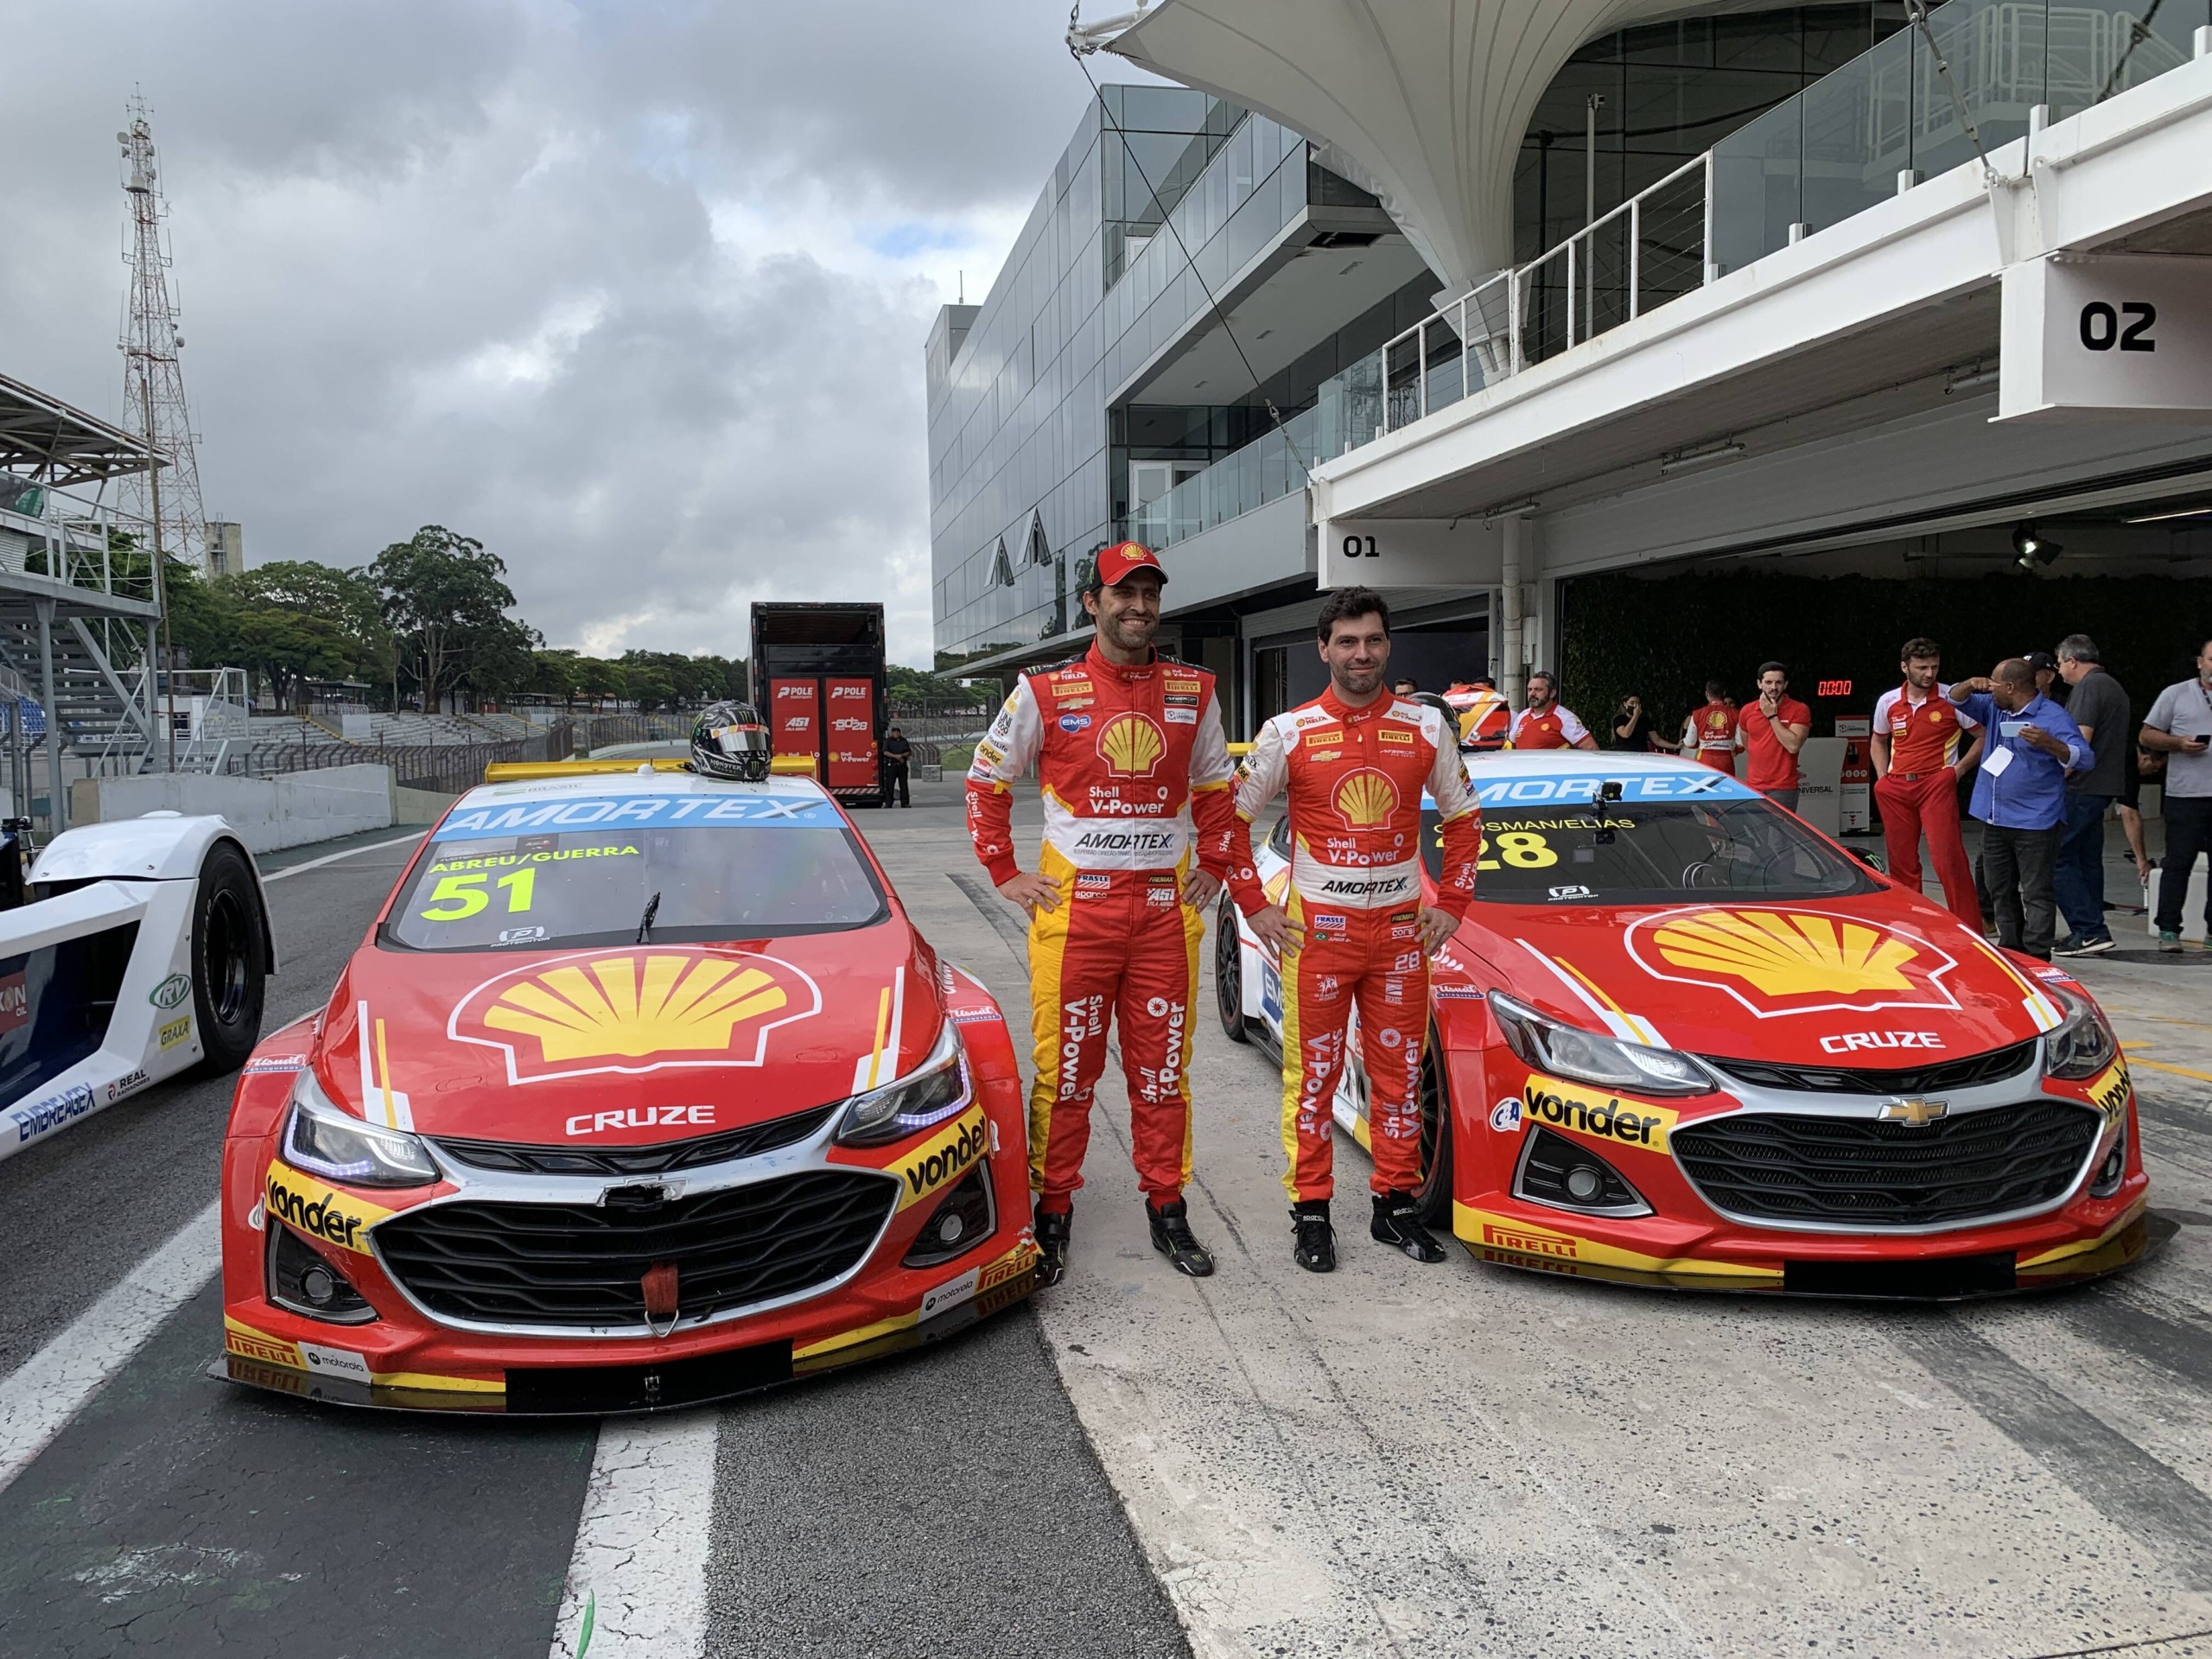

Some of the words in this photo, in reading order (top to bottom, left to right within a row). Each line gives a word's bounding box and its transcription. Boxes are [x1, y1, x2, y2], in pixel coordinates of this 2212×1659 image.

[2080, 301, 2157, 353] 02
[1342, 536, 1381, 558] 01
[1061, 671, 1088, 680] HELIX
[790, 687, 813, 696] POLE
[843, 687, 866, 696] POLE
[1166, 681, 1198, 691] PIRELLI
[1306, 715, 1328, 724] HELIX
[988, 735, 1008, 753] MetLife
[1309, 733, 1340, 744] PIRELLI
[1381, 731, 1410, 741] PIRELLI
[980, 746, 1001, 764] onder
[710, 759, 742, 772] MONSTER
[1089, 786, 1120, 798] Shell
[969, 791, 982, 818] Shell
[1090, 798, 1164, 814] V-Power
[435, 798, 827, 832] AMORTEX
[1074, 833, 1175, 850] AMORTEX
[1326, 837, 1356, 849] Shell
[428, 845, 640, 874] ABREU/GUERRA
[1328, 849, 1400, 865] V-Power
[1320, 876, 1408, 895] AMORTEX
[1454, 863, 1471, 888] Shell
[419, 868, 537, 922] 51
[1548, 893, 1599, 902] PROTECHTOR
[1392, 912, 1415, 922] FREMAX
[490, 936, 551, 948] PROTECHTOR
[1395, 950, 1421, 970] 28
[160, 980, 186, 1004] RV
[16, 1008, 27, 1017] OIL
[955, 1006, 994, 1017] Usual
[1089, 995, 1103, 1036] Shell
[161, 1021, 190, 1046] GRAXA
[1819, 1031, 1947, 1053] CRUZE
[1332, 1027, 1343, 1072] Shell
[251, 1055, 302, 1066] Usual
[117, 1077, 150, 1096] RADIADORES
[119, 1069, 147, 1089] REAL
[1140, 1065, 1158, 1104] Shell
[1300, 1033, 1331, 1135] V-Power
[10, 1082, 96, 1142] EMBREAGEX
[565, 1104, 715, 1136] CRUZE
[1525, 1086, 1662, 1145] vonder
[906, 1116, 987, 1195] vonder
[267, 1174, 362, 1248] vonder
[1483, 1224, 1577, 1257] PIRELLI
[976, 1243, 1038, 1292] PIRELLI
[937, 1281, 974, 1304] motorola
[225, 1326, 300, 1365] PIRELLI
[322, 1357, 365, 1372] motorola
